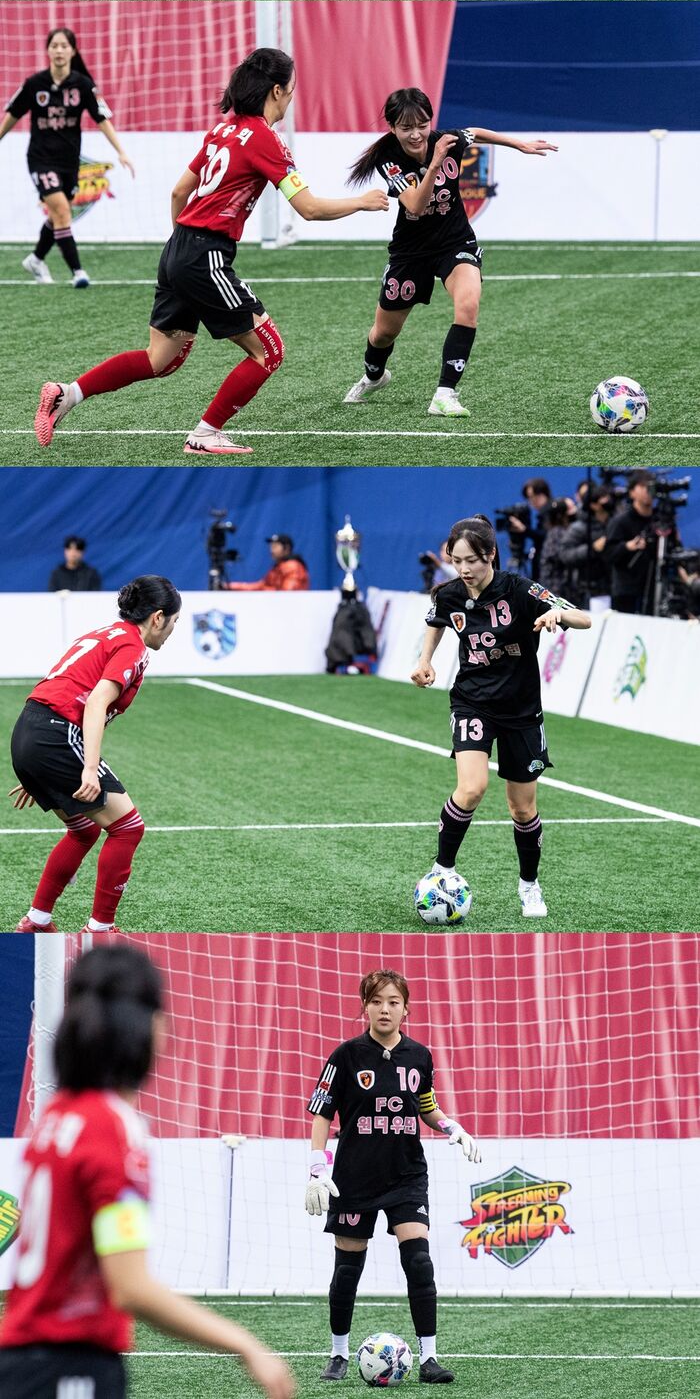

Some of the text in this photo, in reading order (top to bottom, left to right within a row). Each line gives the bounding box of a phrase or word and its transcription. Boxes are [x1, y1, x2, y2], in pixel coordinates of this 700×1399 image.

[62, 88, 80, 107] 13
[40, 171, 60, 190] 13
[290, 175, 302, 188] C
[385, 277, 416, 301] 30
[485, 599, 512, 628] 13
[468, 632, 496, 650] FC
[459, 718, 484, 742] 13
[396, 1066, 421, 1093] 10
[375, 1096, 404, 1113] FC
[357, 1116, 417, 1135] 원더우먼
[461, 1203, 575, 1259] FIGHTER
